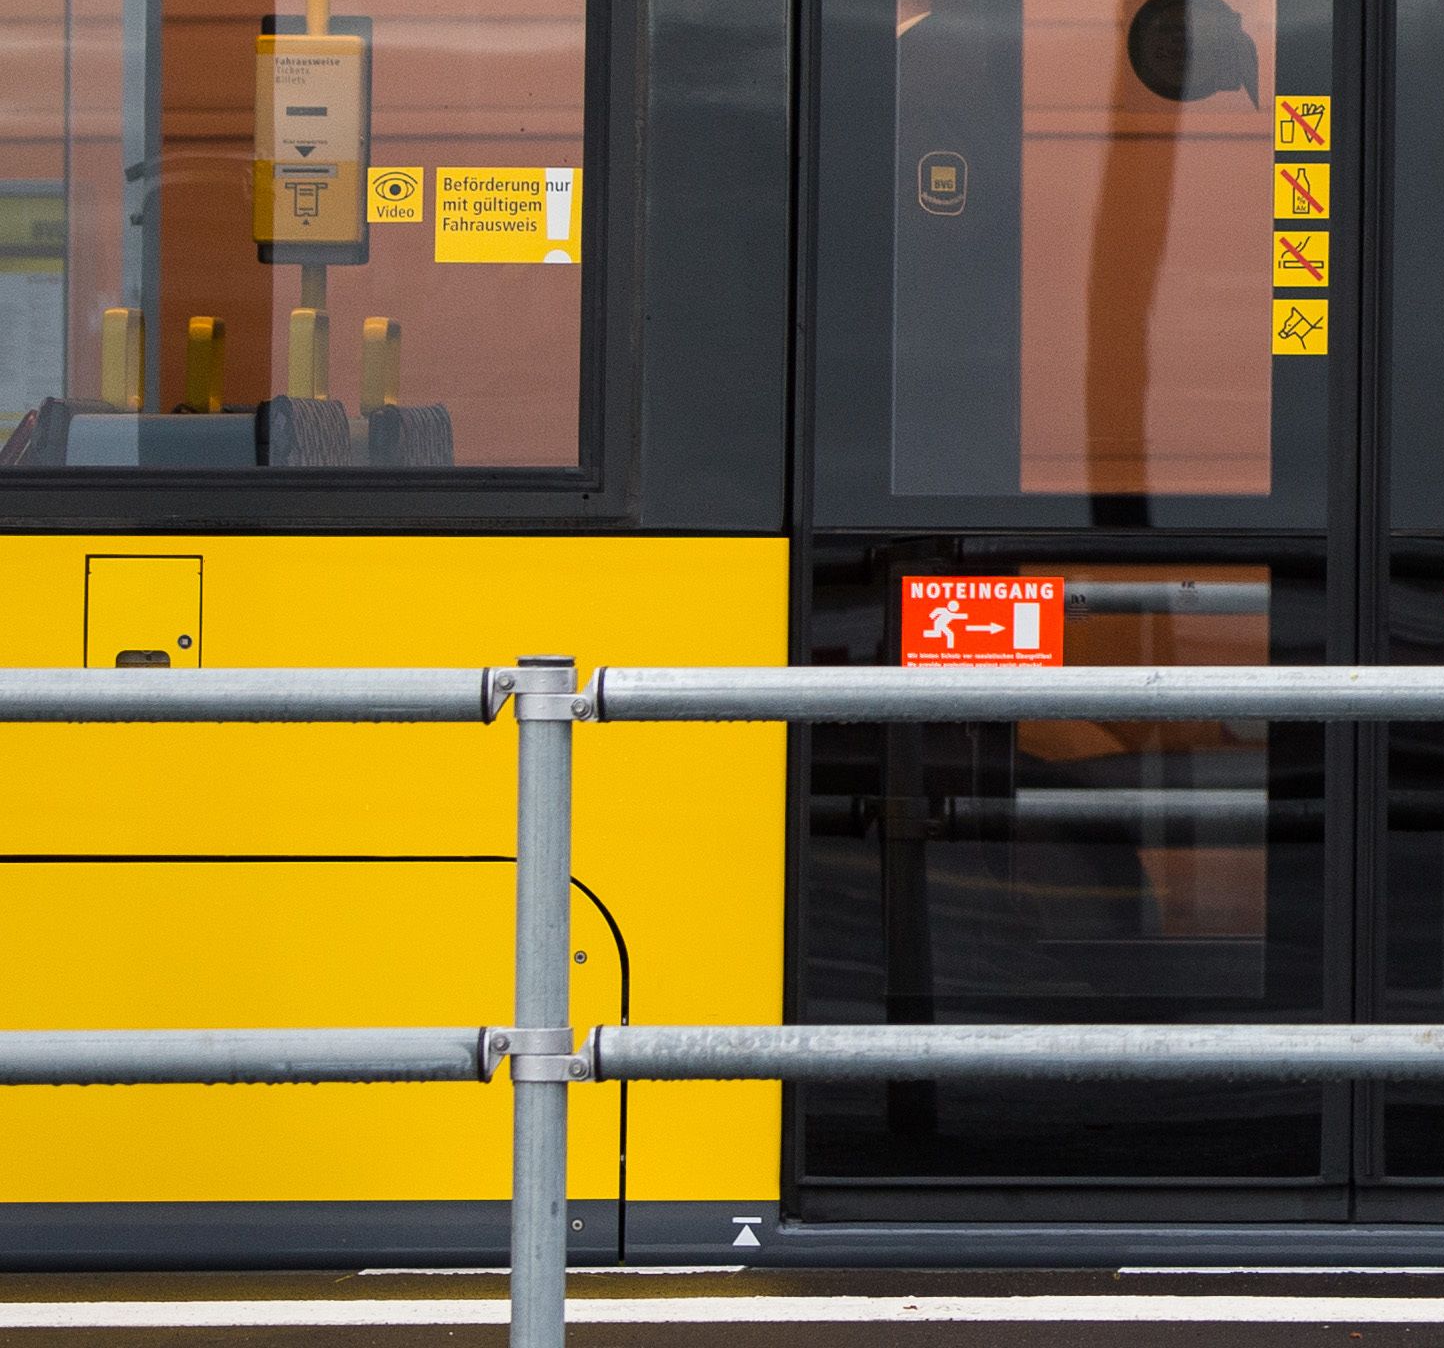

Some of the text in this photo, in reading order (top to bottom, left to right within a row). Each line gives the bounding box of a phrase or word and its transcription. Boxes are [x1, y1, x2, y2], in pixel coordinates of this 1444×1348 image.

[275, 57, 341, 67] Fahrausweise
[443, 177, 571, 196] Beförderung nur
[376, 205, 415, 219] Video
[442, 197, 542, 215] mit gültigem
[443, 217, 538, 232] Fahrausweis
[910, 582, 1055, 600] NOTEINGANG
